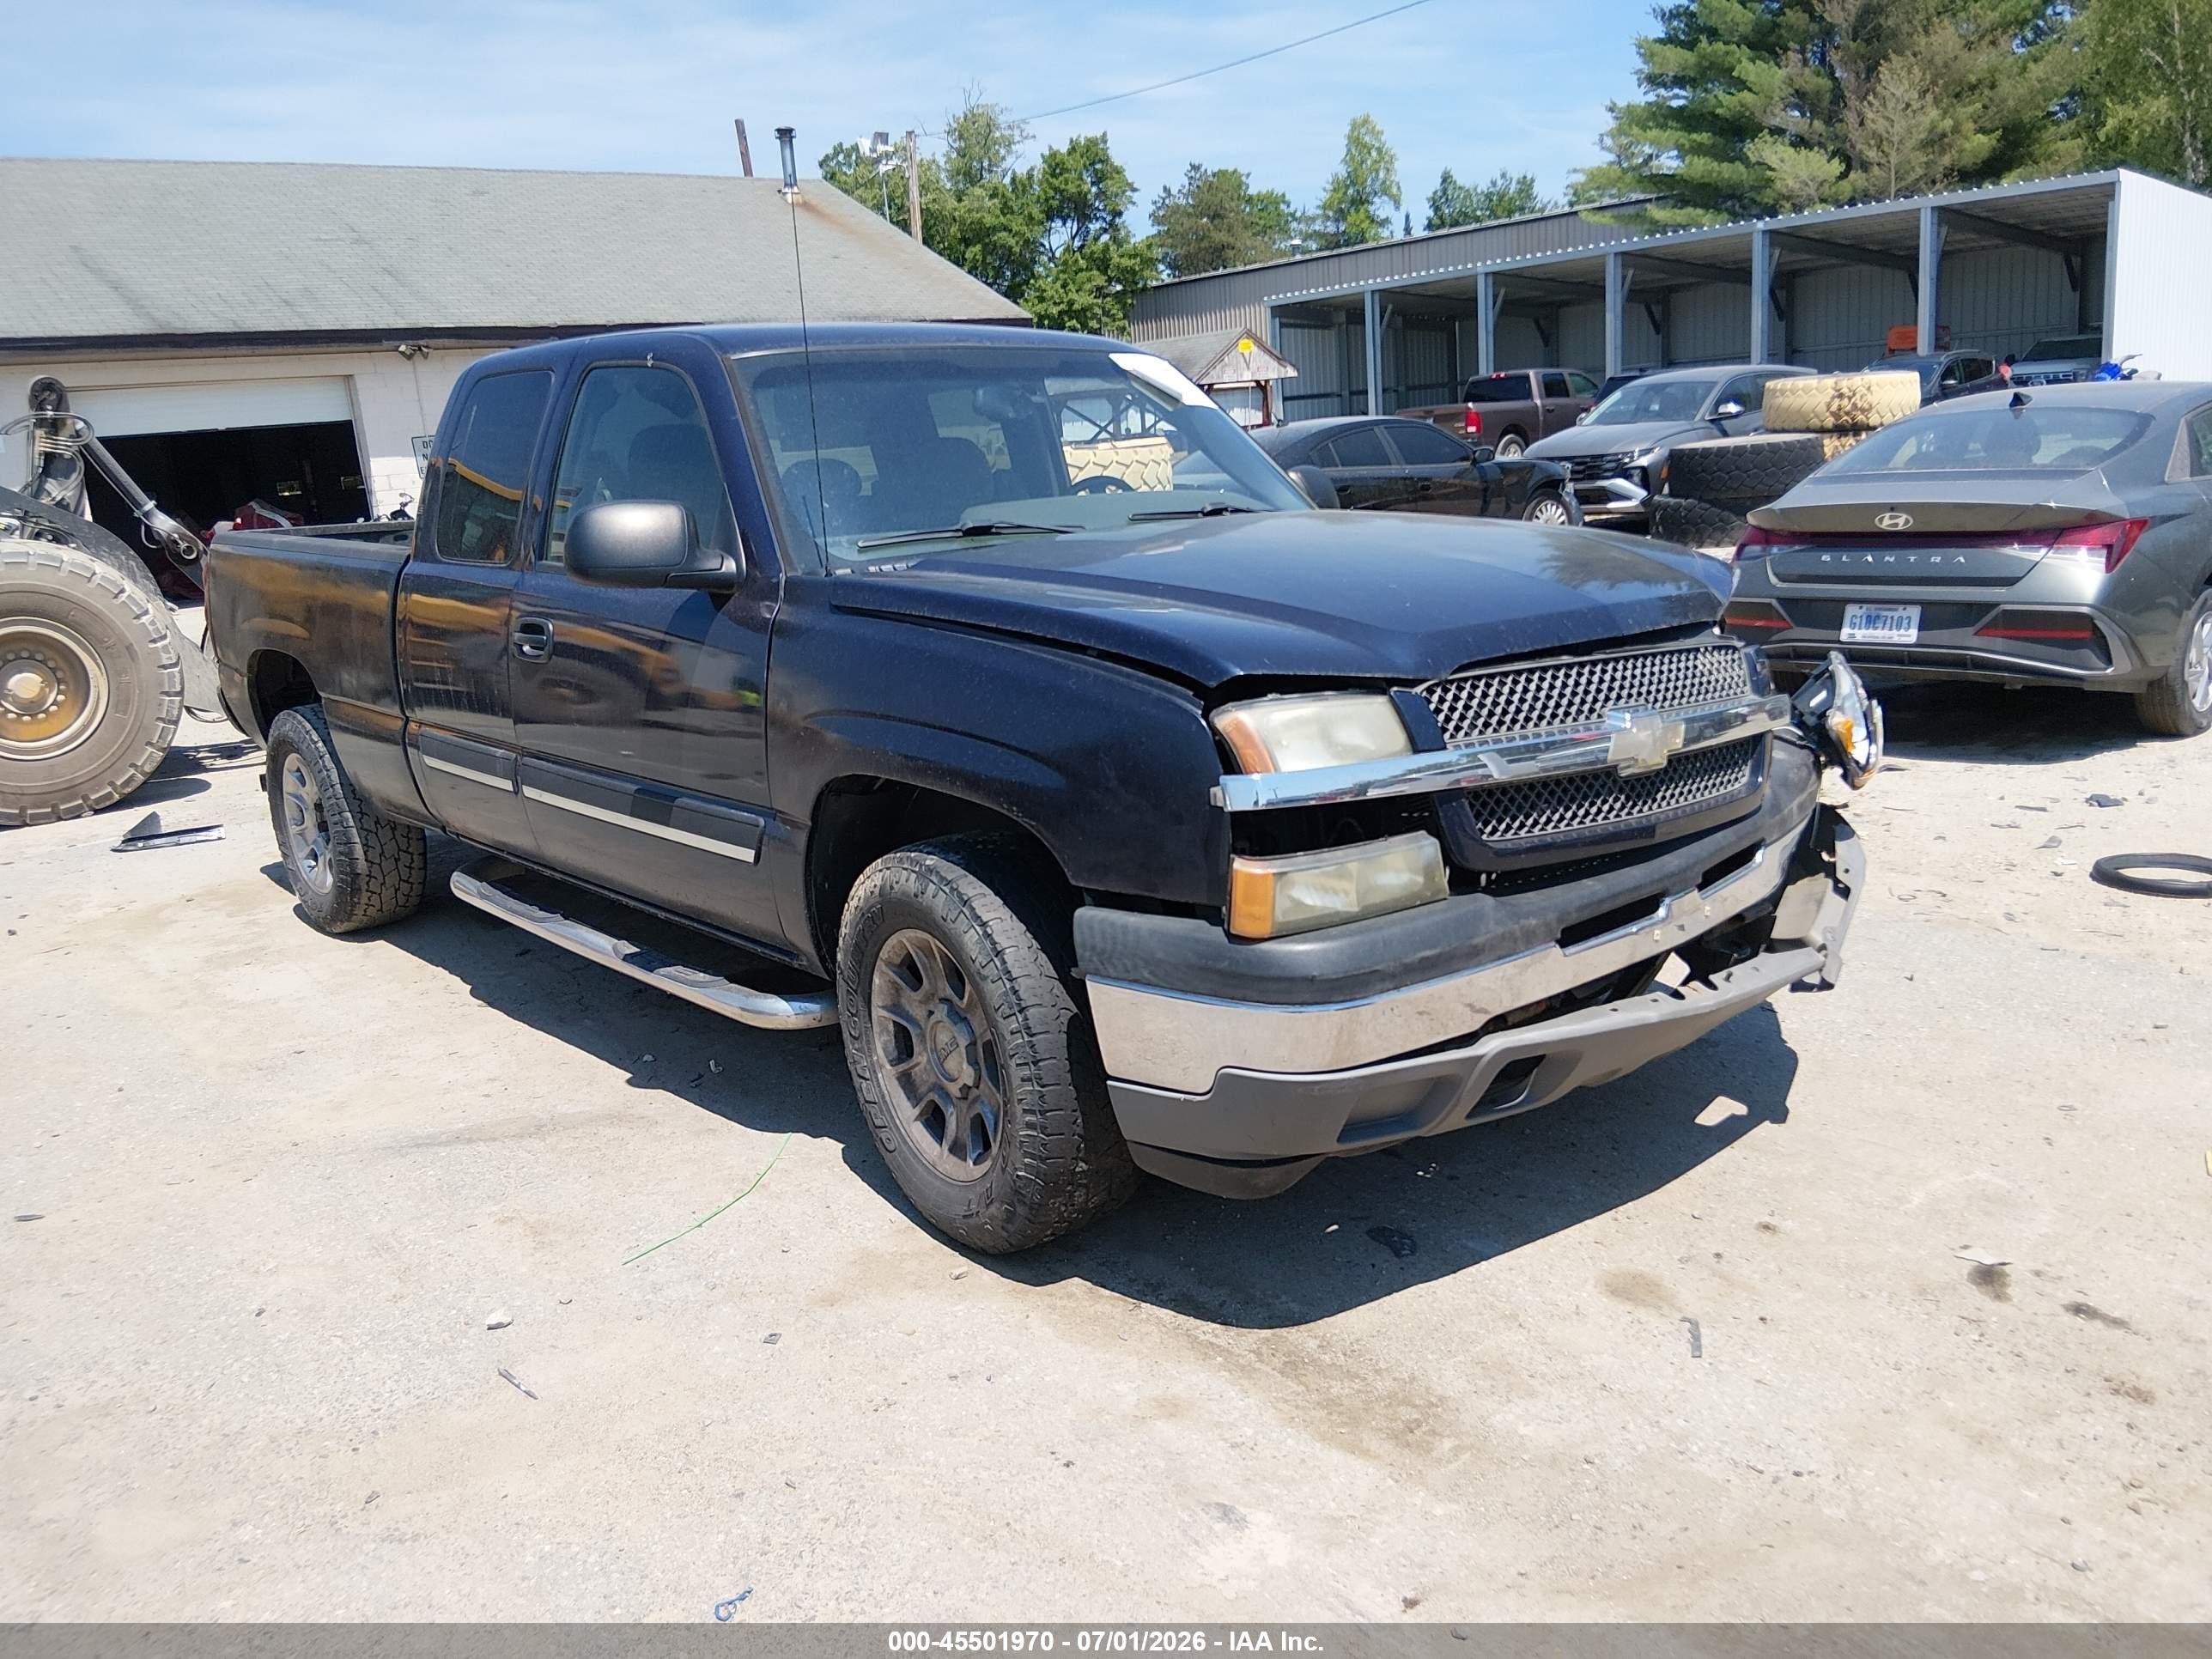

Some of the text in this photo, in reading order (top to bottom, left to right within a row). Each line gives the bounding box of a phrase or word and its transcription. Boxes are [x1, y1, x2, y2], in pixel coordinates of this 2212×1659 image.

[1820, 554, 1966, 564] ELANTRA
[842, 904, 897, 1154] OPEN COUNTRY
